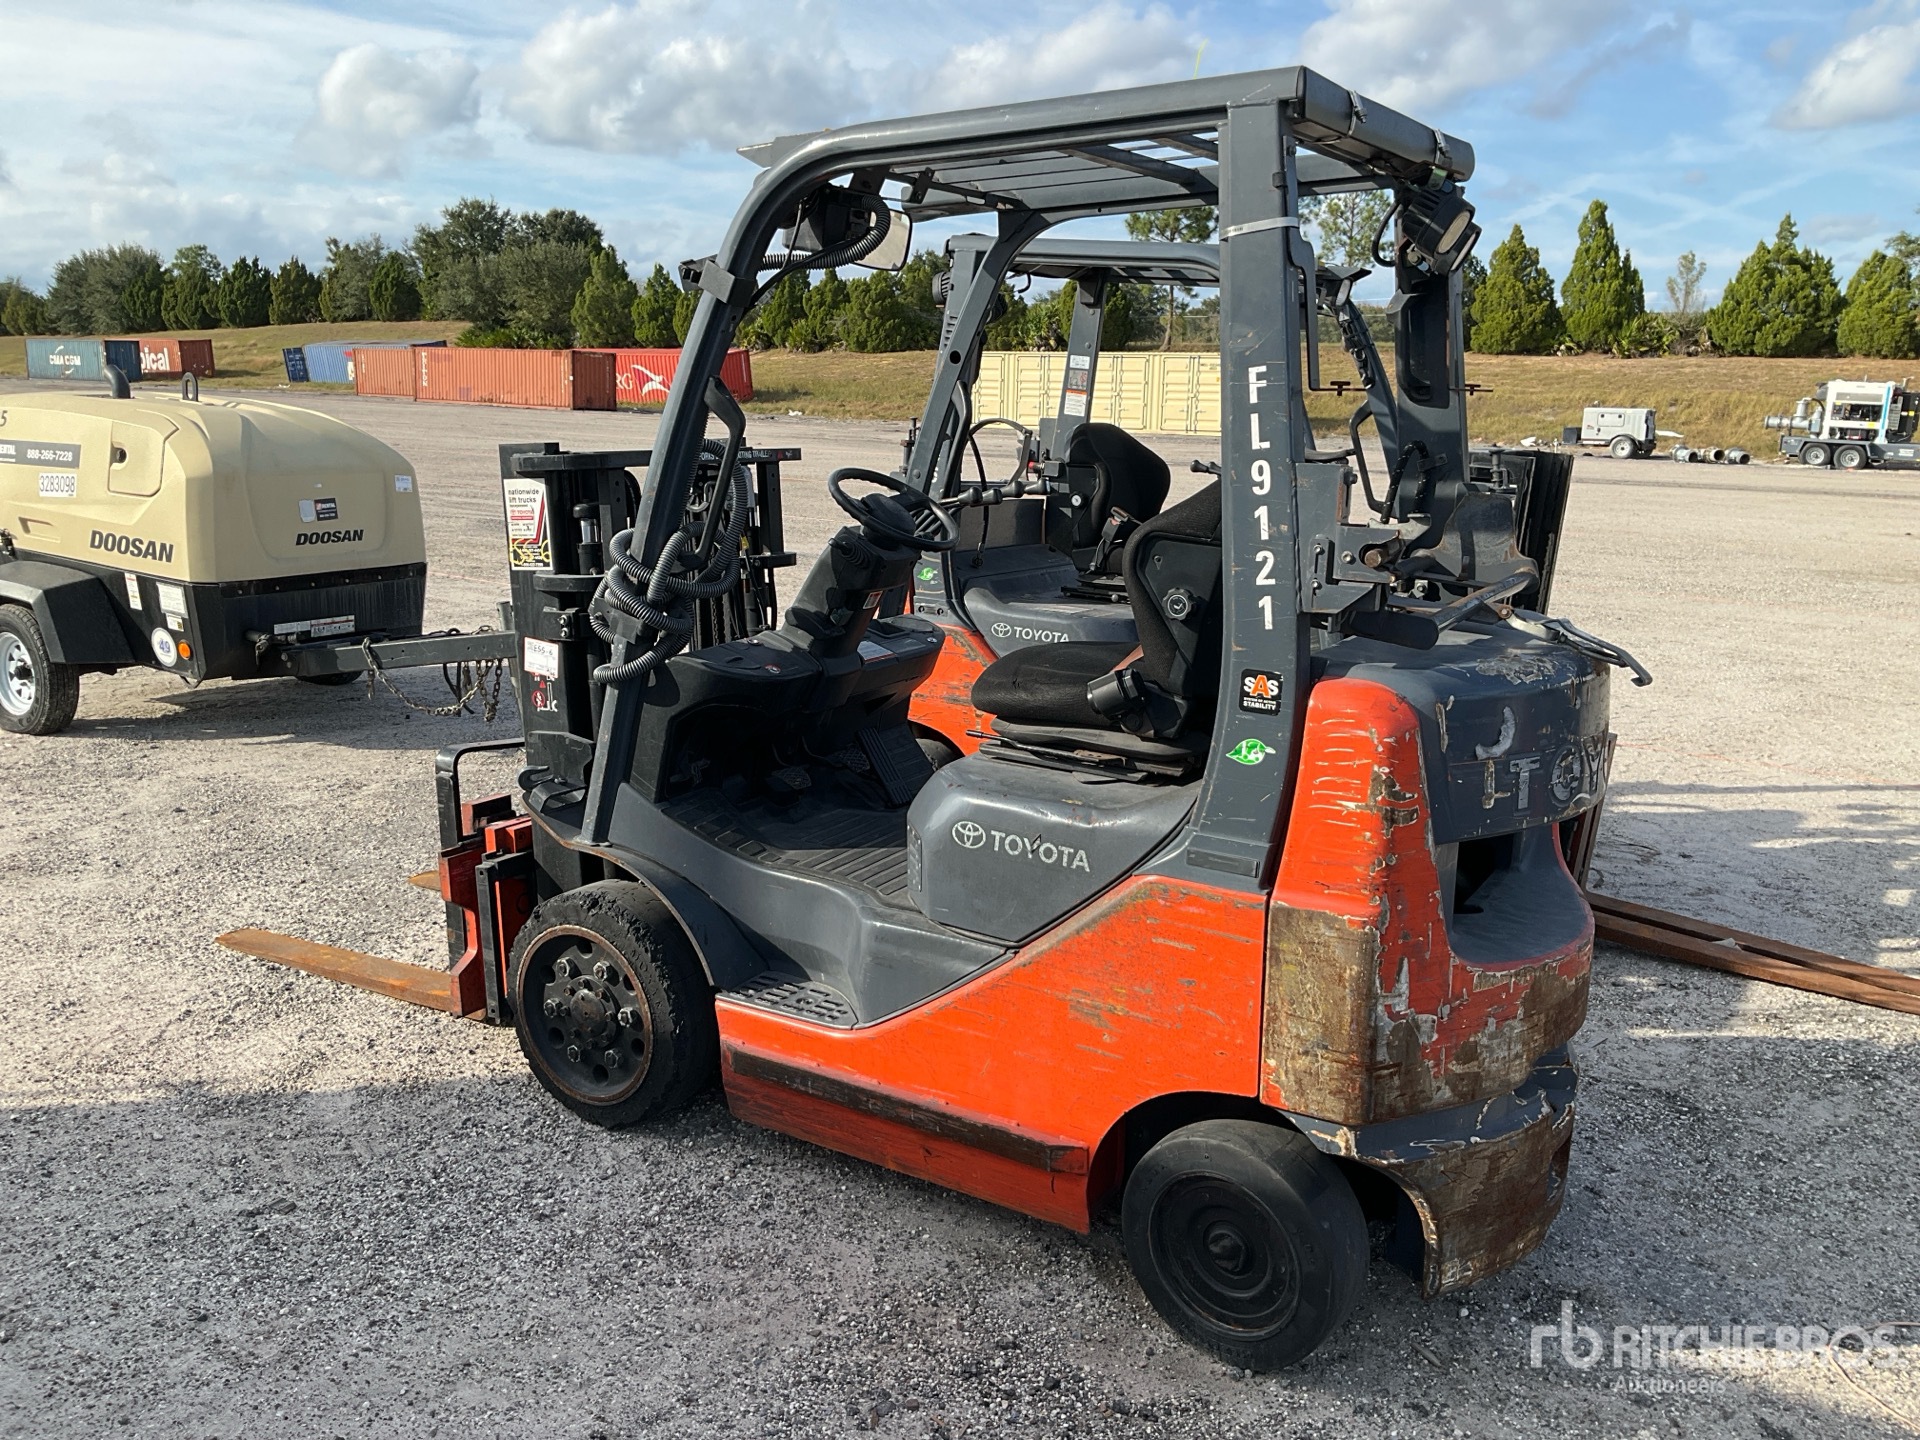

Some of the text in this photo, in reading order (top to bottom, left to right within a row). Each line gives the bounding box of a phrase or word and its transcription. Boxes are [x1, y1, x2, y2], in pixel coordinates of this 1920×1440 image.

[49, 354, 64, 365] CMA
[39, 475, 76, 493] 3283098
[1248, 365, 1276, 631] FL9121
[89, 529, 174, 563] DOOSAN
[296, 529, 365, 546] DOOSAN
[1013, 626, 1070, 644] TOYOTA
[1243, 675, 1278, 698] SAS
[1243, 700, 1276, 710] STABILITY
[990, 829, 1090, 873] TOYOTA
